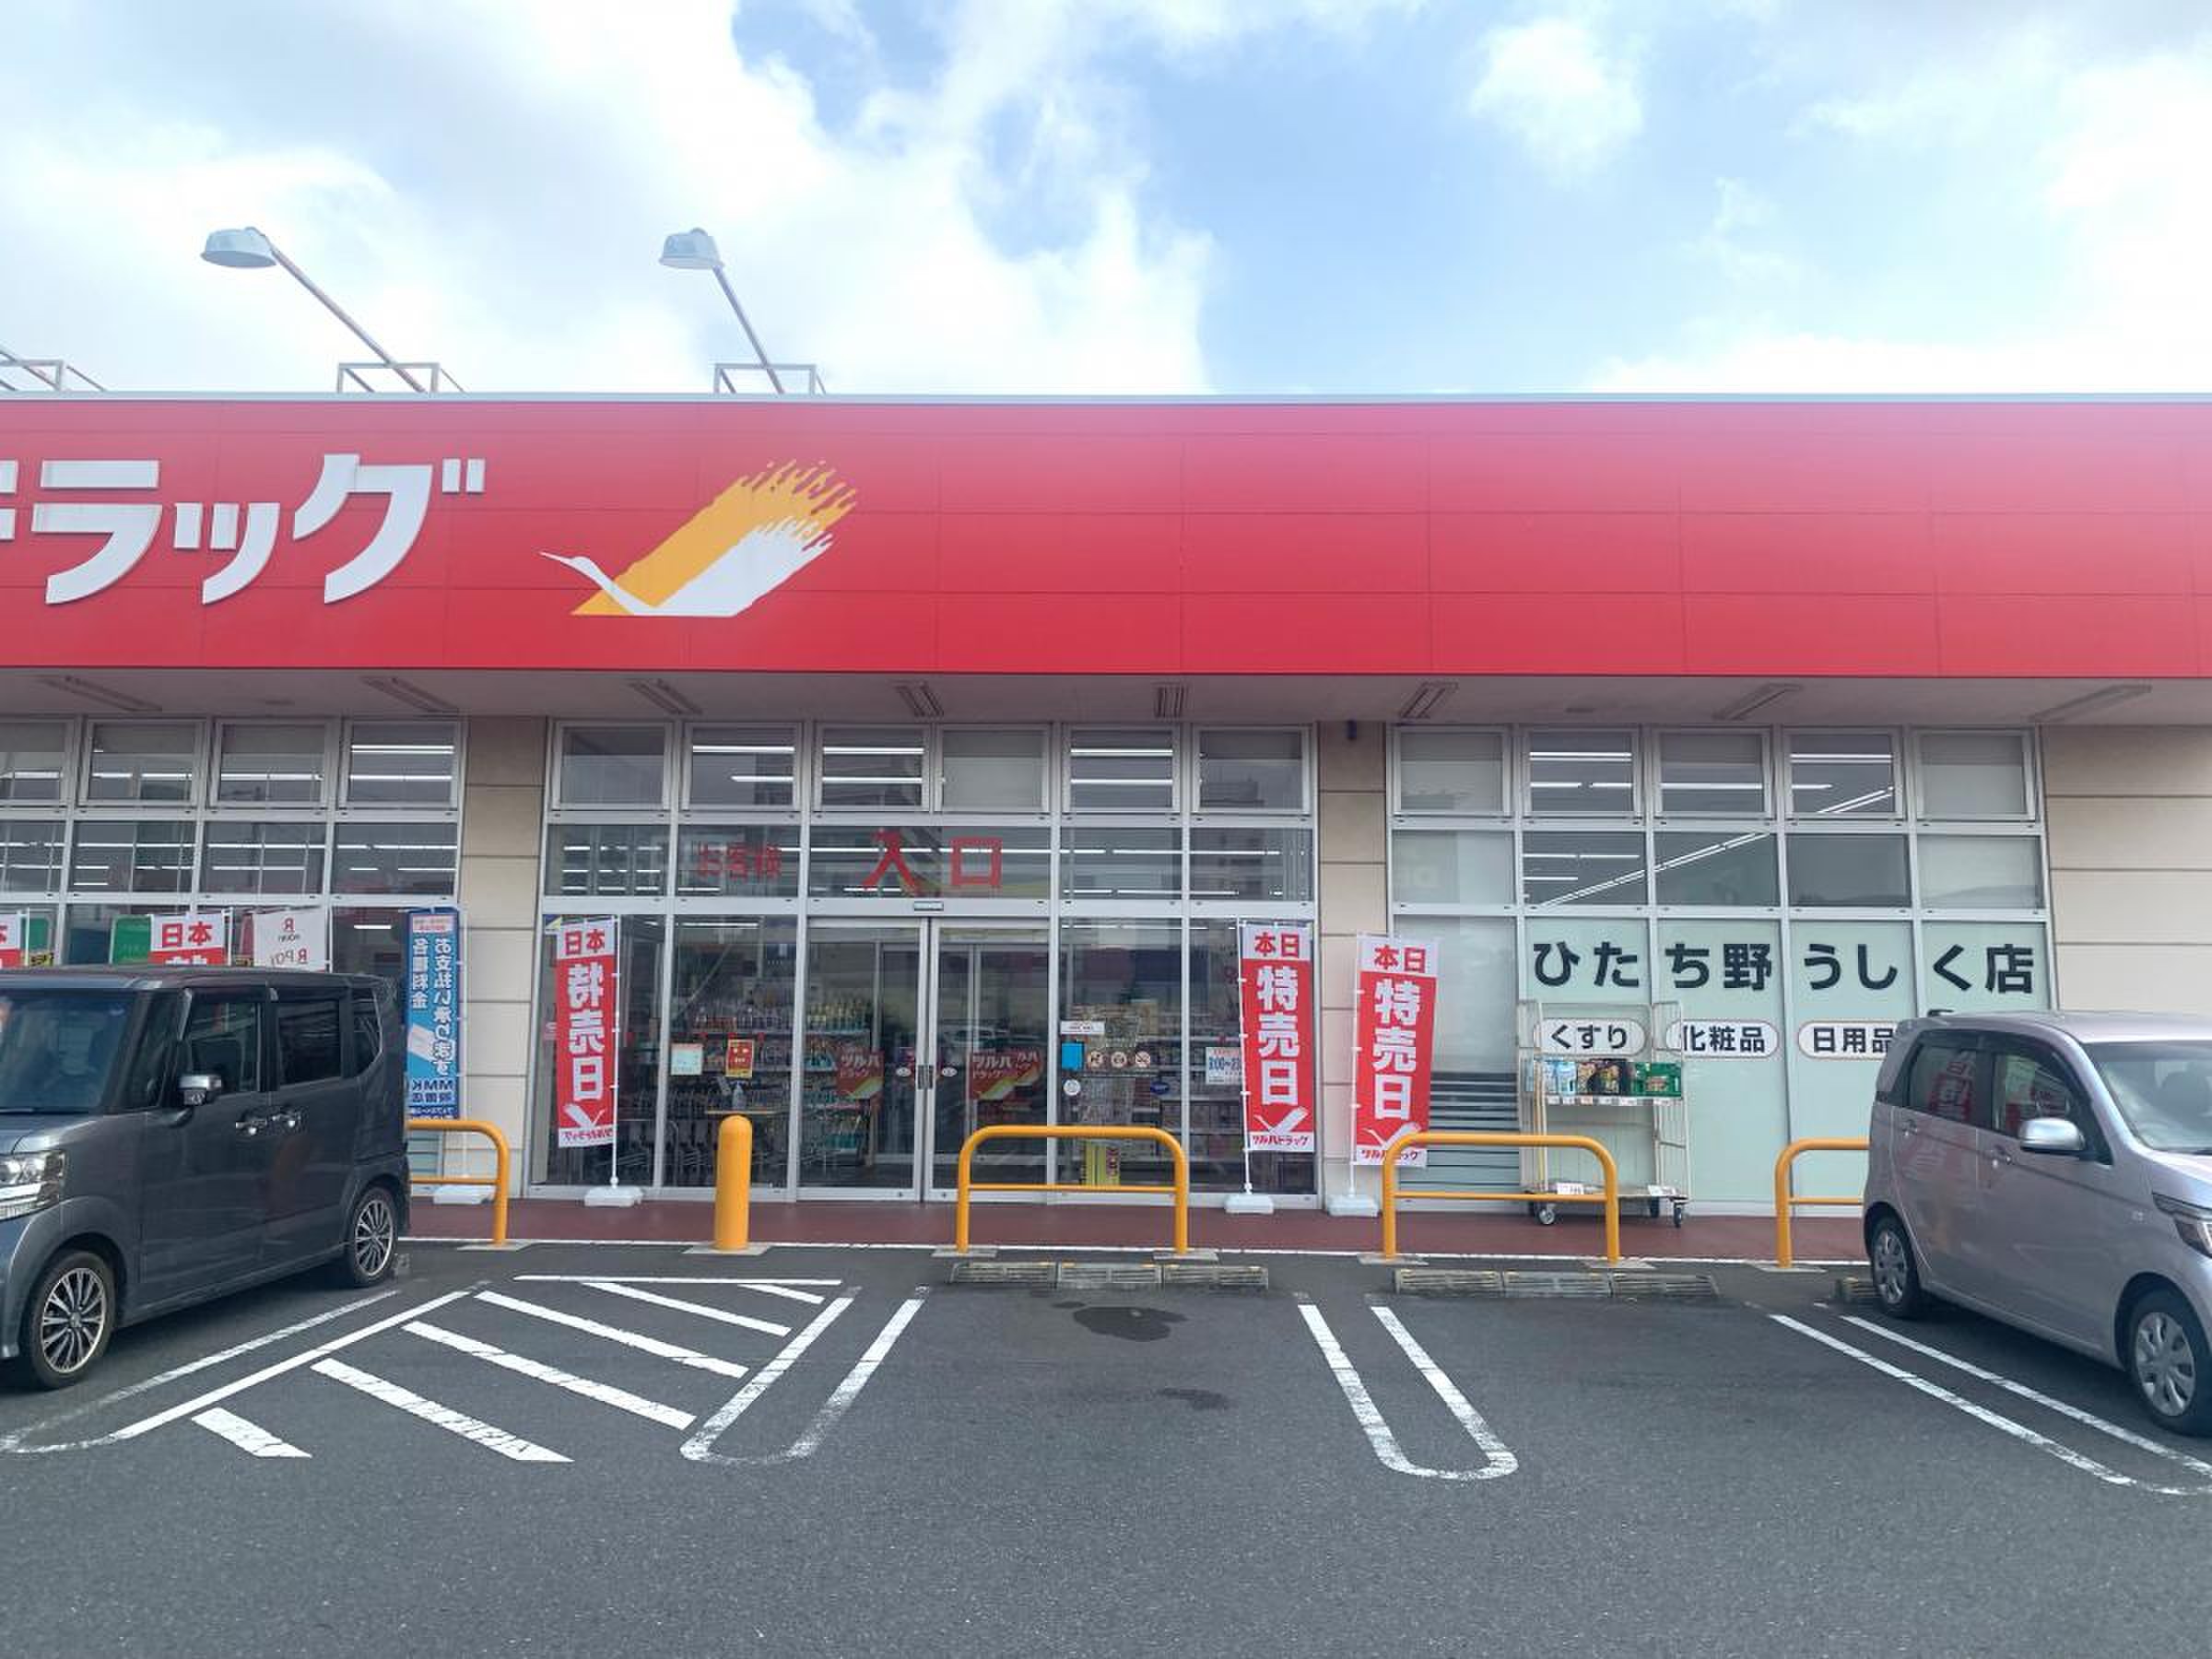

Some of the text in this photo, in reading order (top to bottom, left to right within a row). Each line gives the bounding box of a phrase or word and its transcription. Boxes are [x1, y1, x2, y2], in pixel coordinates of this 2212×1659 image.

[0, 453, 486, 605] ラッグ
[861, 827, 1003, 894] 入口
[1254, 932, 1300, 958] 本日
[1374, 945, 1426, 973] 本日
[1533, 942, 2035, 994] ひたち野うしく店
[1257, 966, 1300, 1106] 特売日
[1372, 979, 1421, 1121] 特売日
[1549, 1024, 1629, 1050] くすり
[1682, 1025, 1766, 1053] 化粧品
[1812, 1027, 1895, 1053] 日用品
